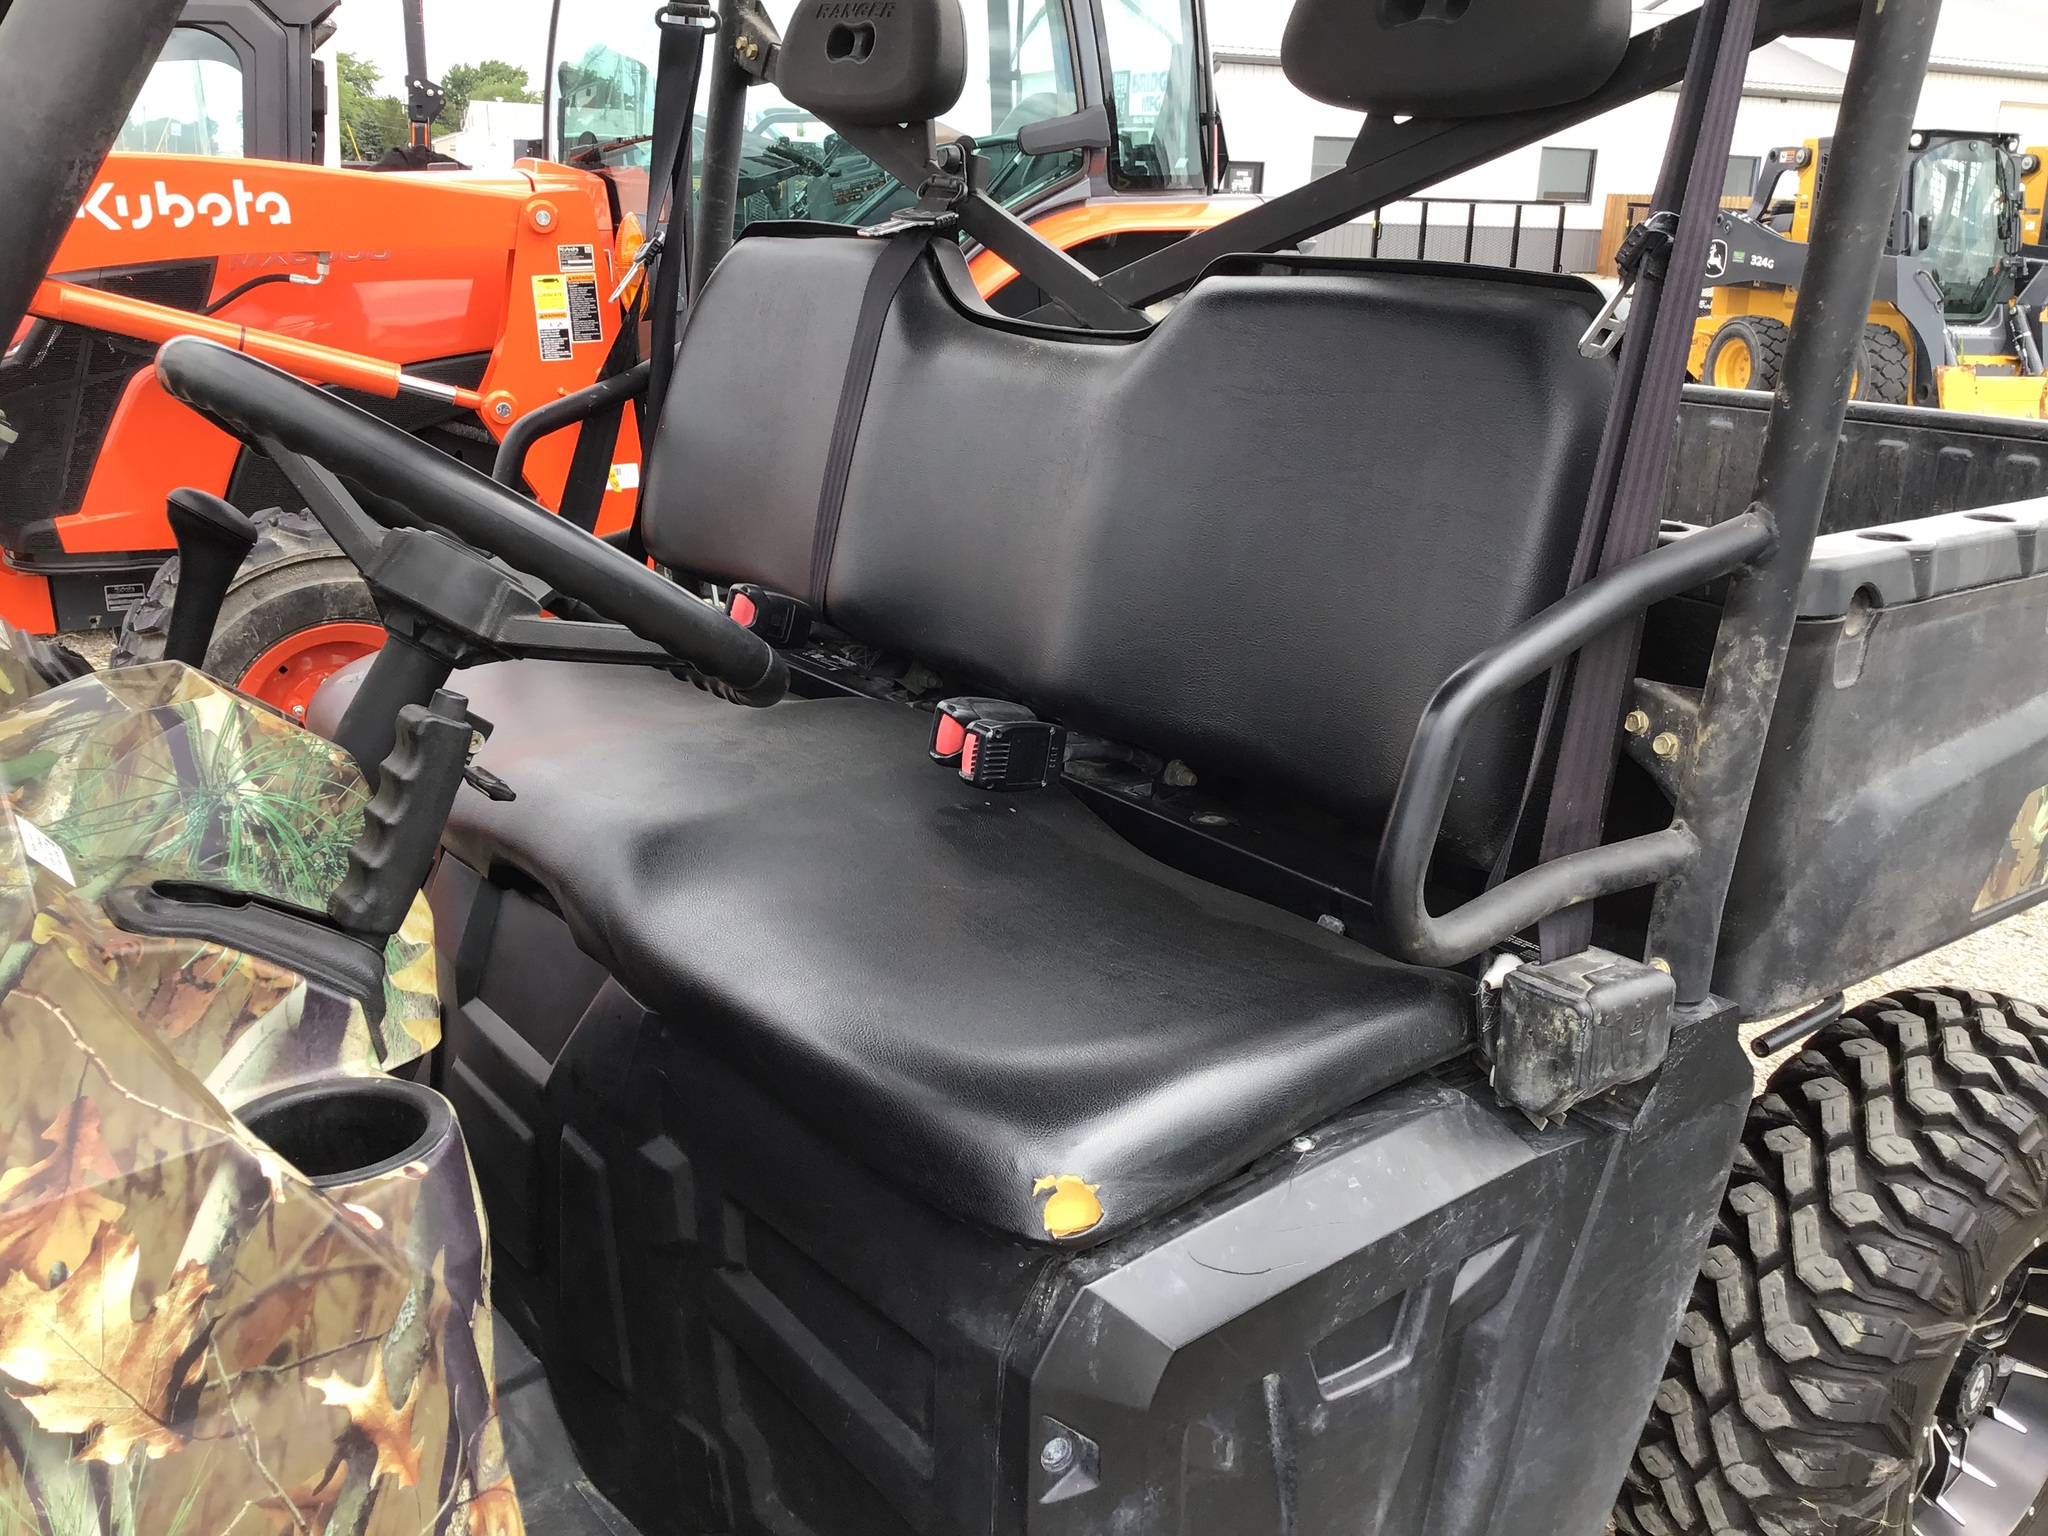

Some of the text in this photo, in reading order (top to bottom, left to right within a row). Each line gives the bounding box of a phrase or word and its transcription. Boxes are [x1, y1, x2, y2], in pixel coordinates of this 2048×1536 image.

[816, 2, 896, 19] RANGER
[76, 179, 292, 230] Kubota
[1750, 255, 1774, 269] 324G
